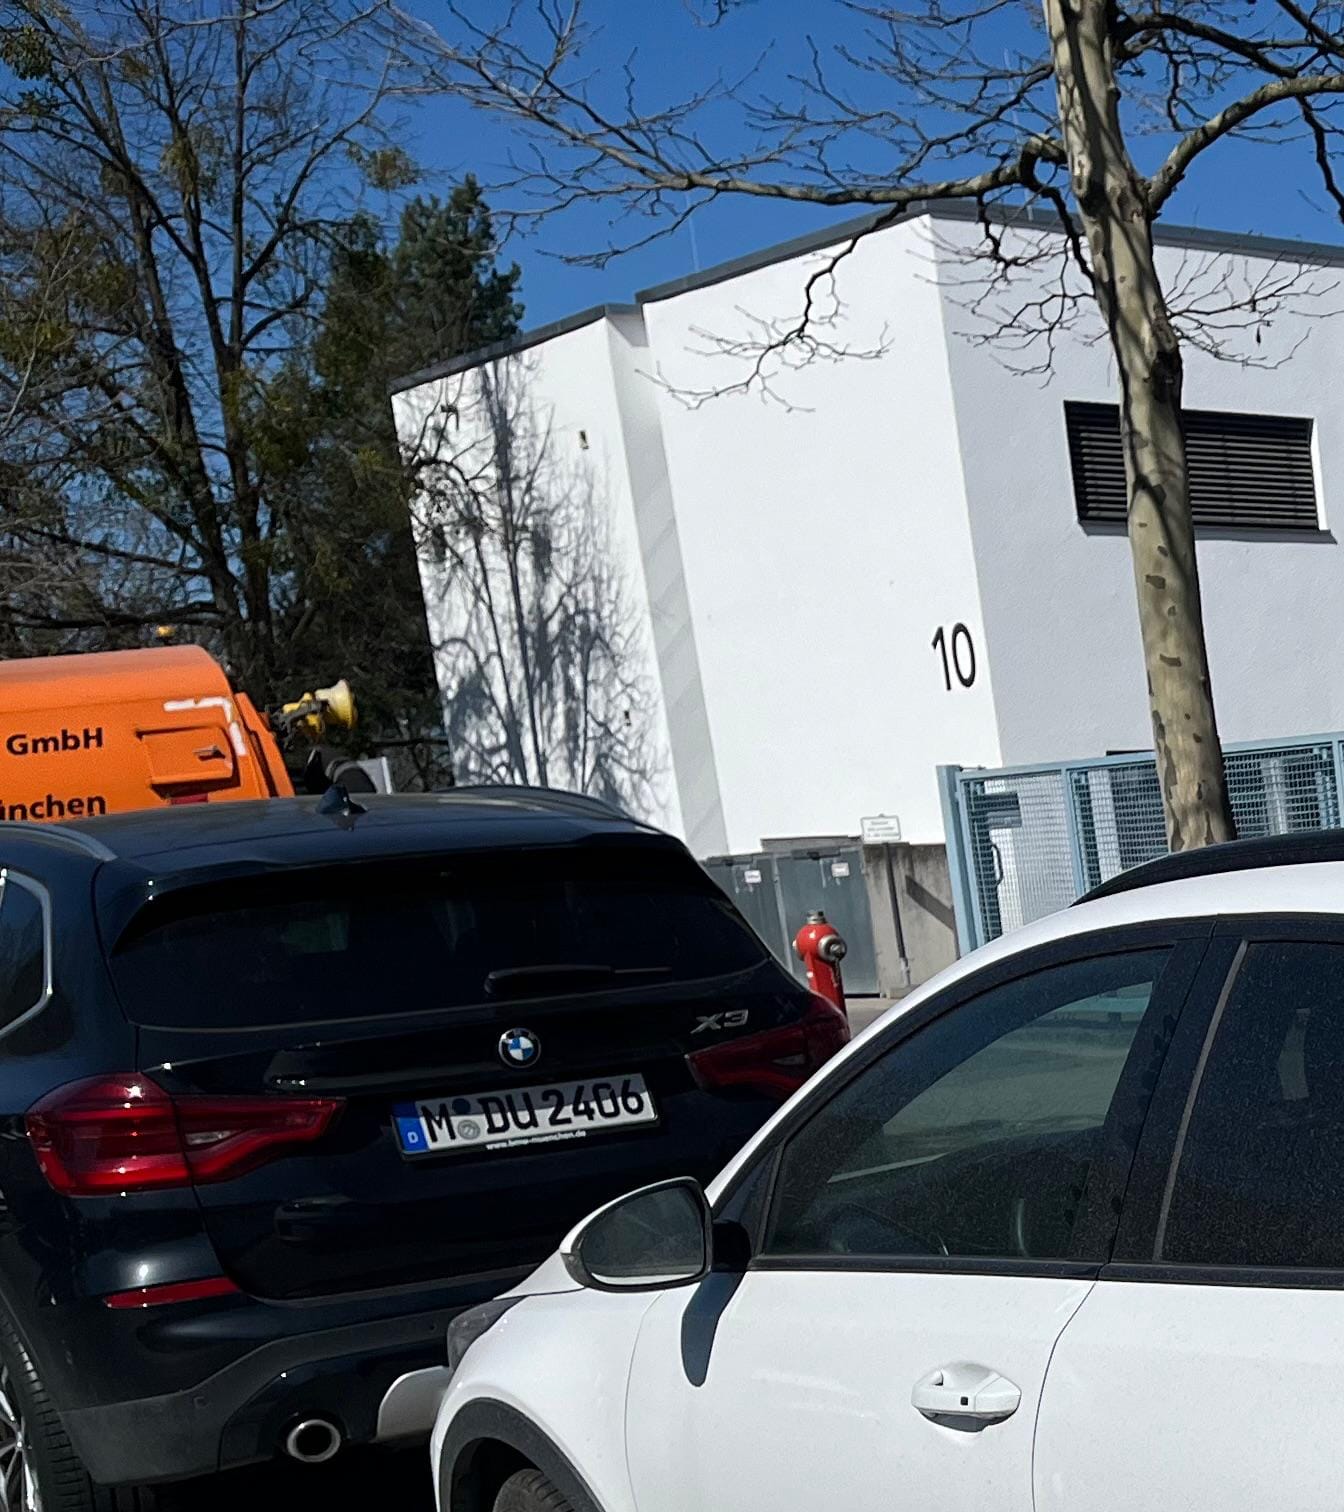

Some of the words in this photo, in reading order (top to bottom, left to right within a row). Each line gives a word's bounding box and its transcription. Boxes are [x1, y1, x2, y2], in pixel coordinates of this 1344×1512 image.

[931, 622, 976, 691] 10
[6, 727, 103, 755] GmbH
[690, 1009, 749, 1034] X3
[421, 1103, 456, 1142] M
[477, 1091, 539, 1135] DU
[541, 1079, 645, 1127] 2406
[407, 1131, 418, 1143] D
